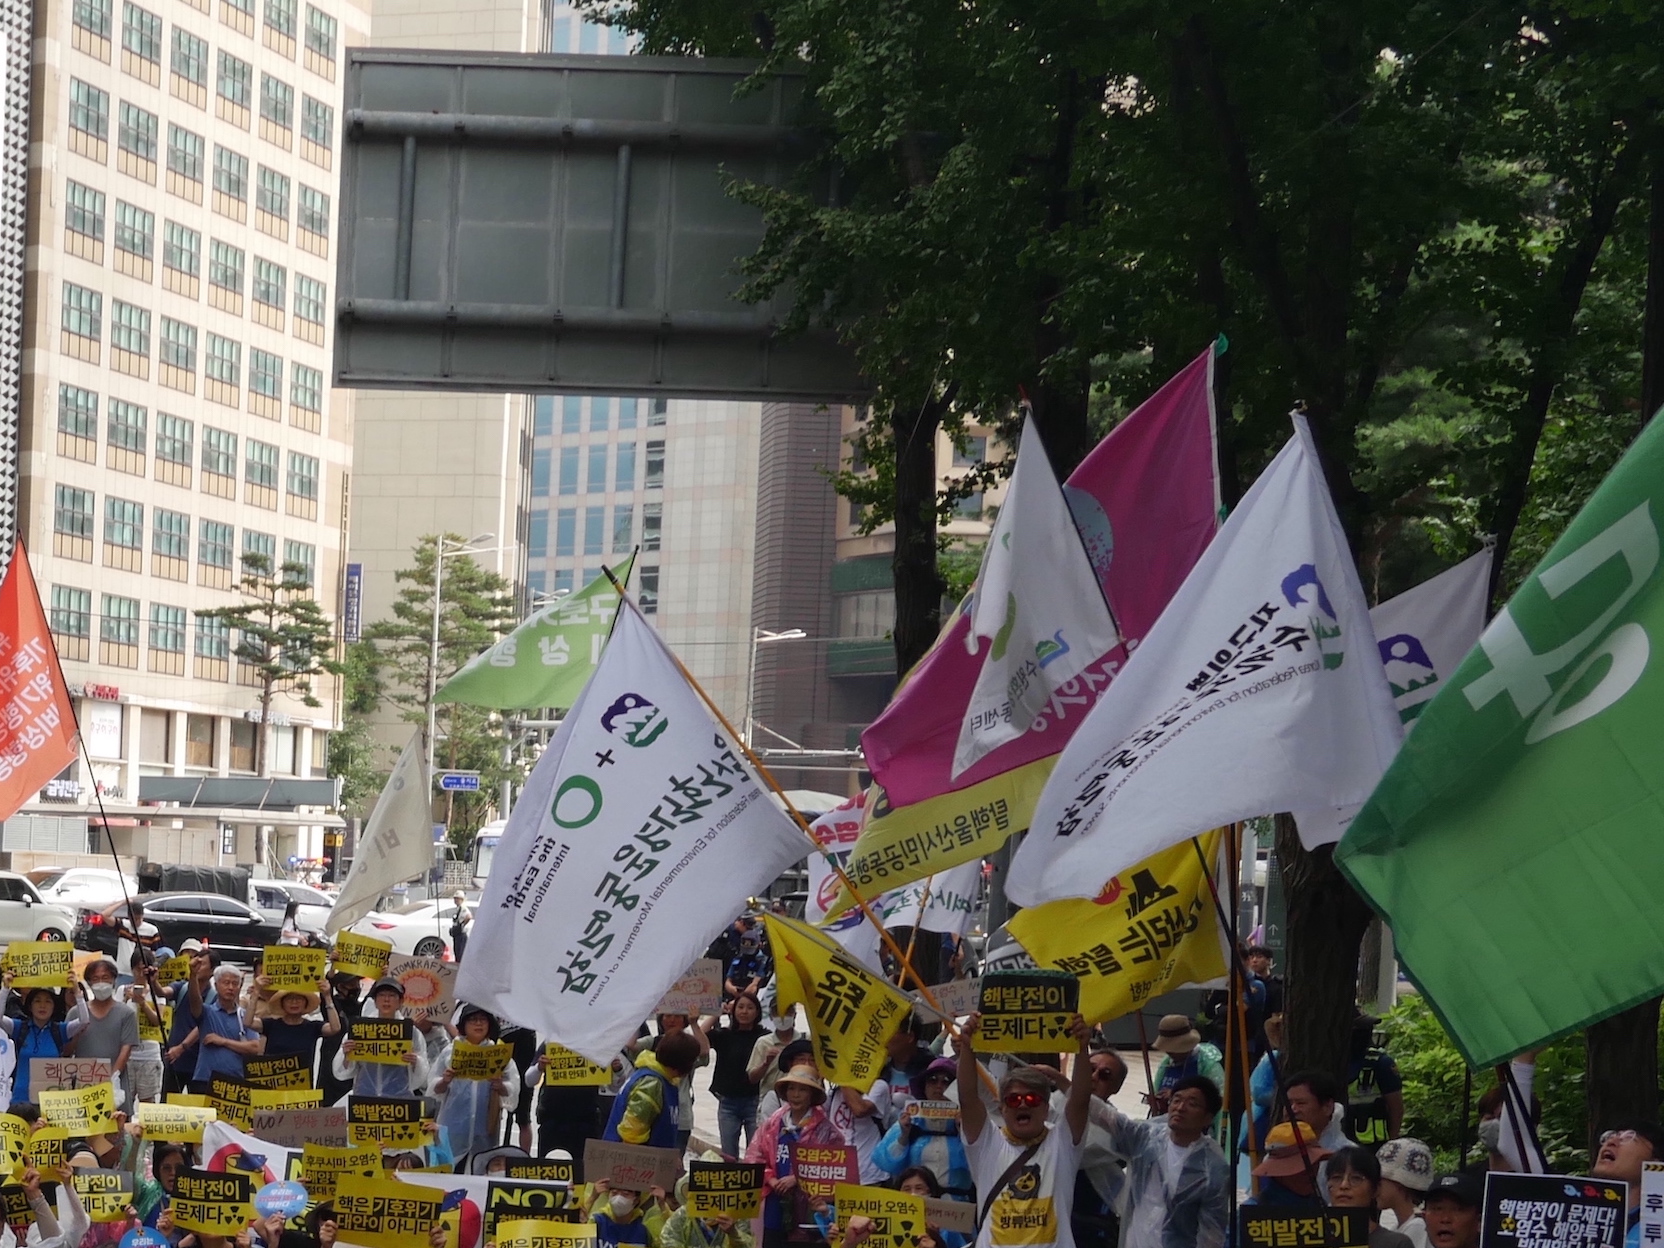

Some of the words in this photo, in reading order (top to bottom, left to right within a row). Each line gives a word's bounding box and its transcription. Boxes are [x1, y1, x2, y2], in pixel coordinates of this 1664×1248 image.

[390, 958, 451, 981] ATOMKRAFT?
[983, 986, 1065, 1010] 핵발전이
[351, 1023, 404, 1039] 핵발전이
[981, 1015, 1046, 1040] 문제다
[352, 1103, 409, 1122] 핵발전이
[353, 1126, 395, 1142] 문제다
[796, 1147, 846, 1163] 오염수가
[692, 1168, 755, 1189] 핵발전이
[798, 1164, 847, 1180] 안전하면
[337, 1198, 369, 1214] 핵은
[373, 1199, 435, 1217] 기후위기
[694, 1193, 740, 1212] 문제다
[838, 1198, 882, 1215] 후쿠시마
[885, 1198, 918, 1215] 오염수
[1499, 1199, 1565, 1221] 핵발전이
[1568, 1204, 1617, 1224] 문제다!
